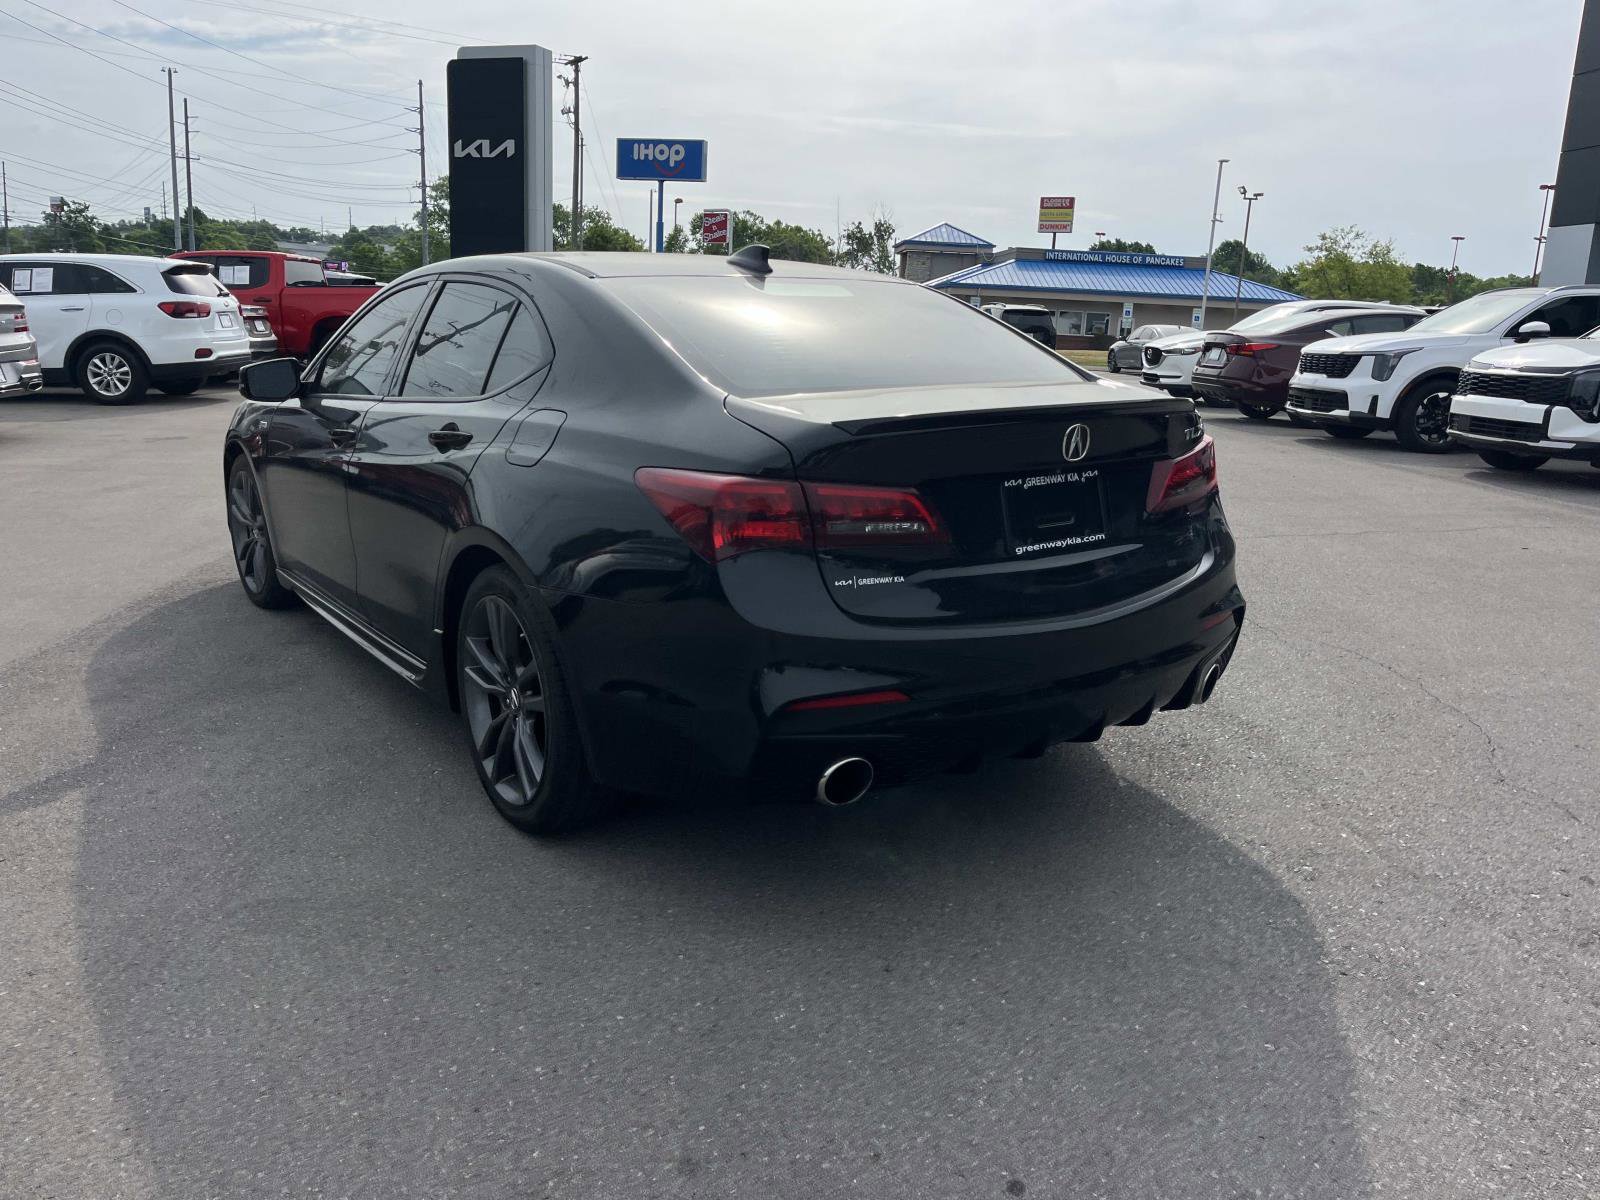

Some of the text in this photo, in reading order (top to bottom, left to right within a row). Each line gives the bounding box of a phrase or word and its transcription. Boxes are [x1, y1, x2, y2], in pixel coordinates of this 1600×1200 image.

[453, 139, 516, 158] KIA
[704, 214, 727, 227] Steak
[704, 229, 727, 242] Shake
[1045, 251, 1184, 266] INTERNATIONAL HOUSE OF PANCAKES
[1025, 474, 1066, 487] GREENWAY
[1067, 472, 1080, 482] KIA
[1015, 533, 1106, 555] greenwaykia.com
[857, 576, 894, 586] GREENWAY
[893, 575, 905, 583] KIA
